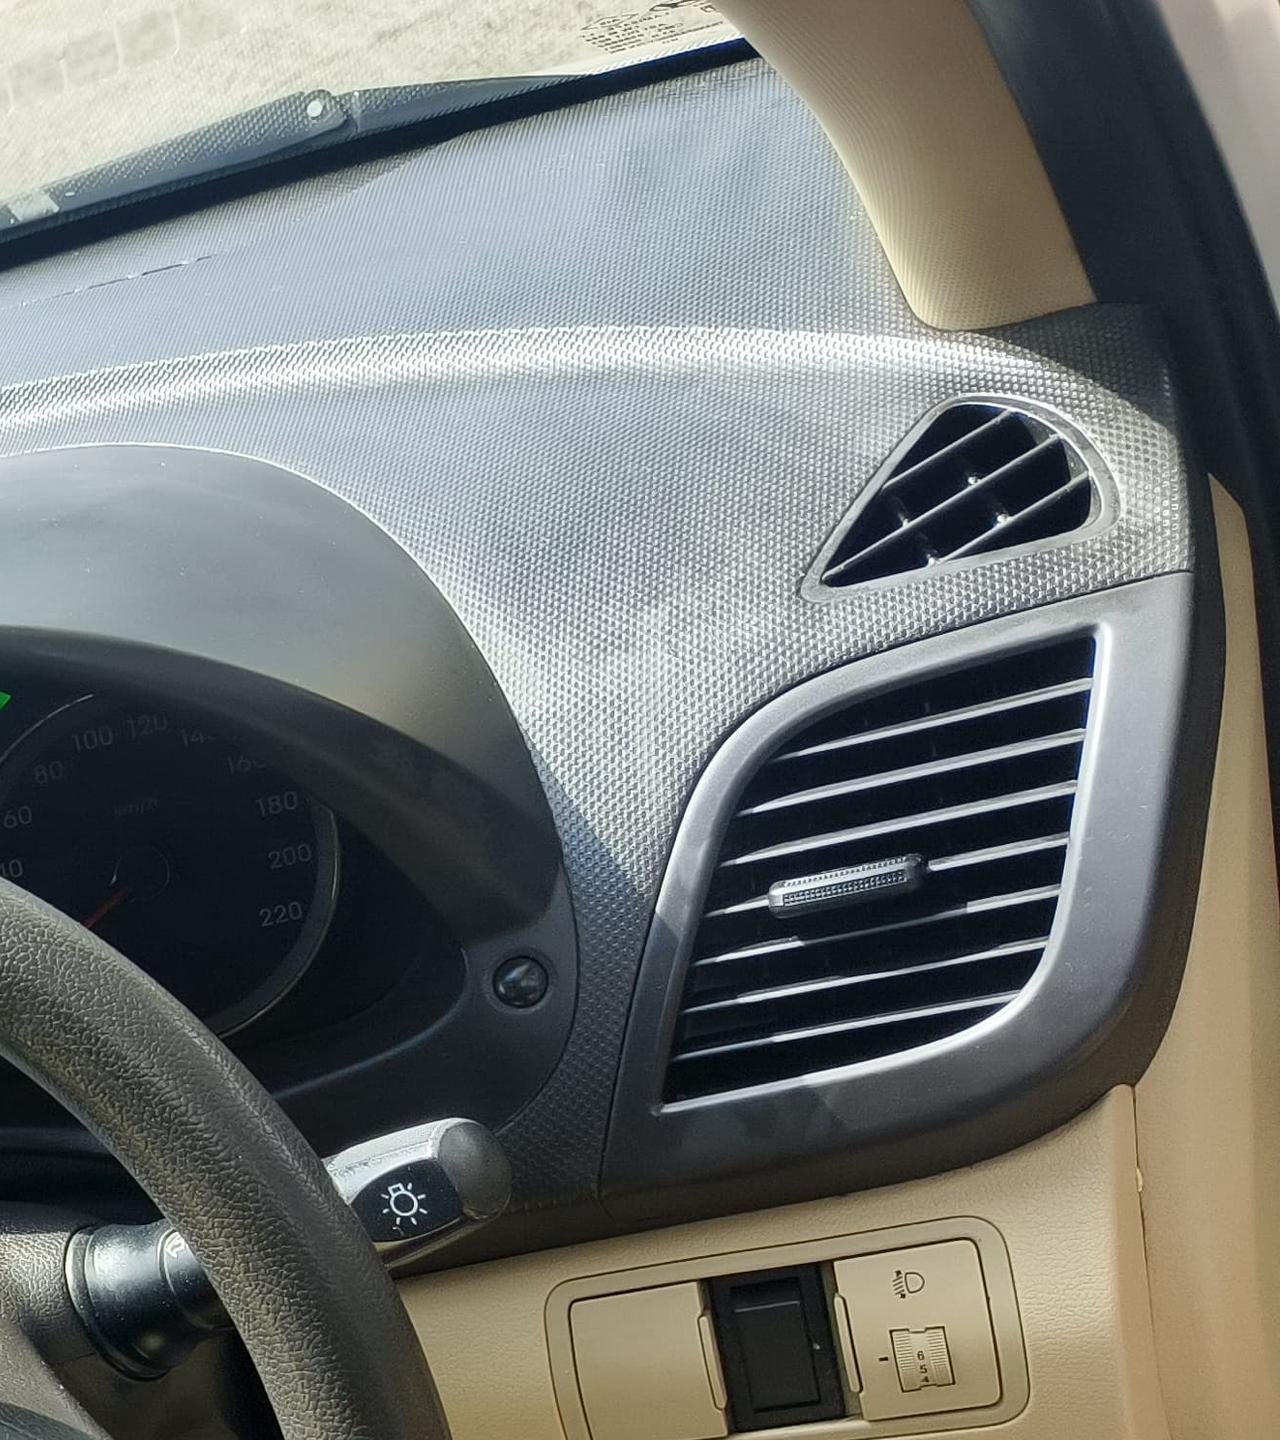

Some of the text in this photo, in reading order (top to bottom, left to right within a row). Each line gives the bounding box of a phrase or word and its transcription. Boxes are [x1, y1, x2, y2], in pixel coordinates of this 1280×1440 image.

[72, 725, 114, 752] 100
[33, 761, 64, 785] 80
[255, 791, 298, 817] 180
[3, 806, 33, 829] 60
[268, 844, 313, 870] 200
[258, 901, 303, 927] 220
[917, 1350, 925, 1361] 6
[920, 1364, 928, 1374] 5
